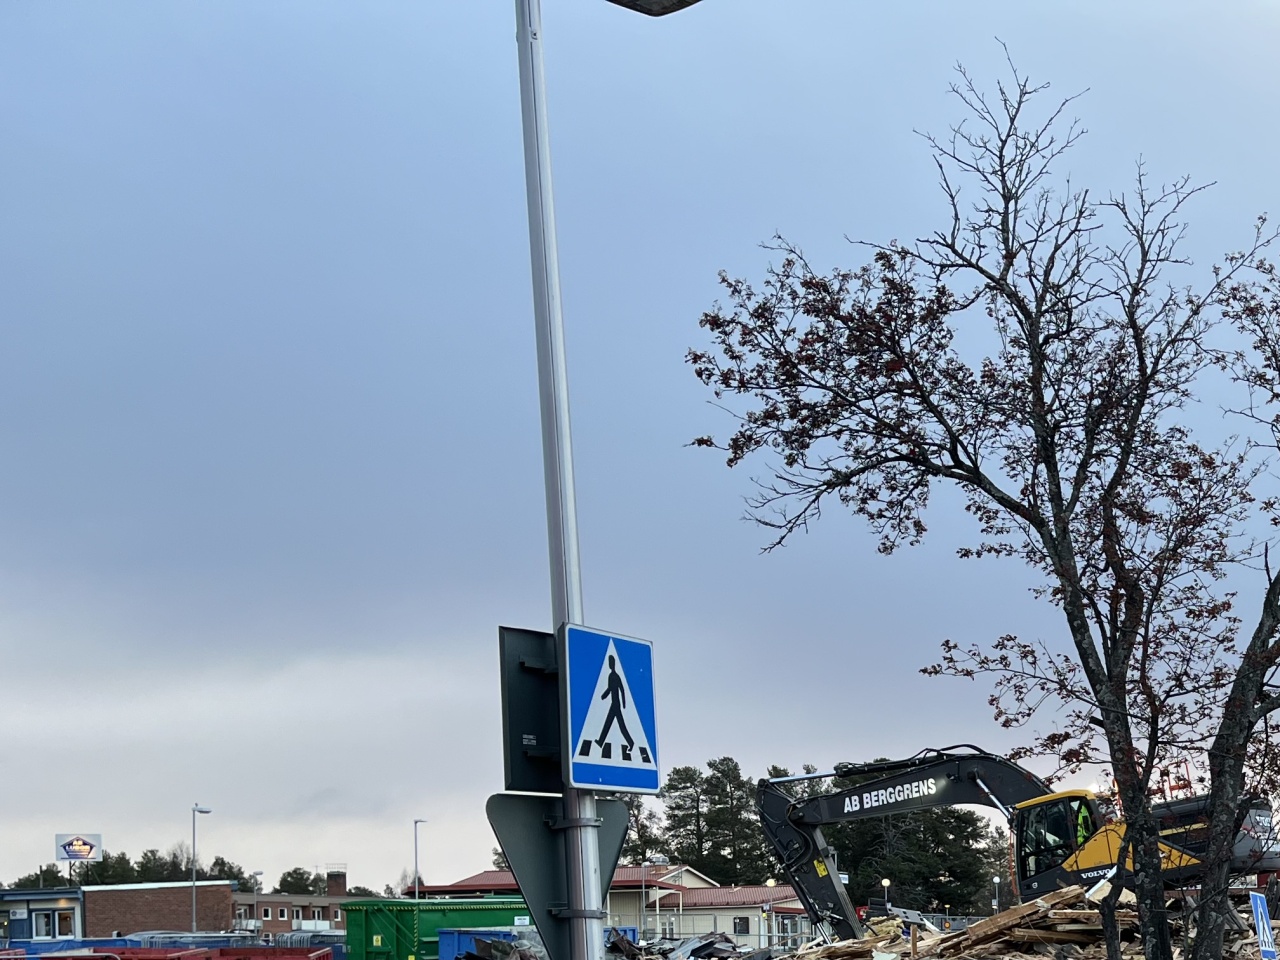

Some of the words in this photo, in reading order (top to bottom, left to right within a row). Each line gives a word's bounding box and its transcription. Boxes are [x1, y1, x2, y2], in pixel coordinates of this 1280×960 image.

[844, 795, 860, 813] AB
[863, 778, 936, 809] BERGGRENS
[1081, 868, 1111, 879] VOLVO
